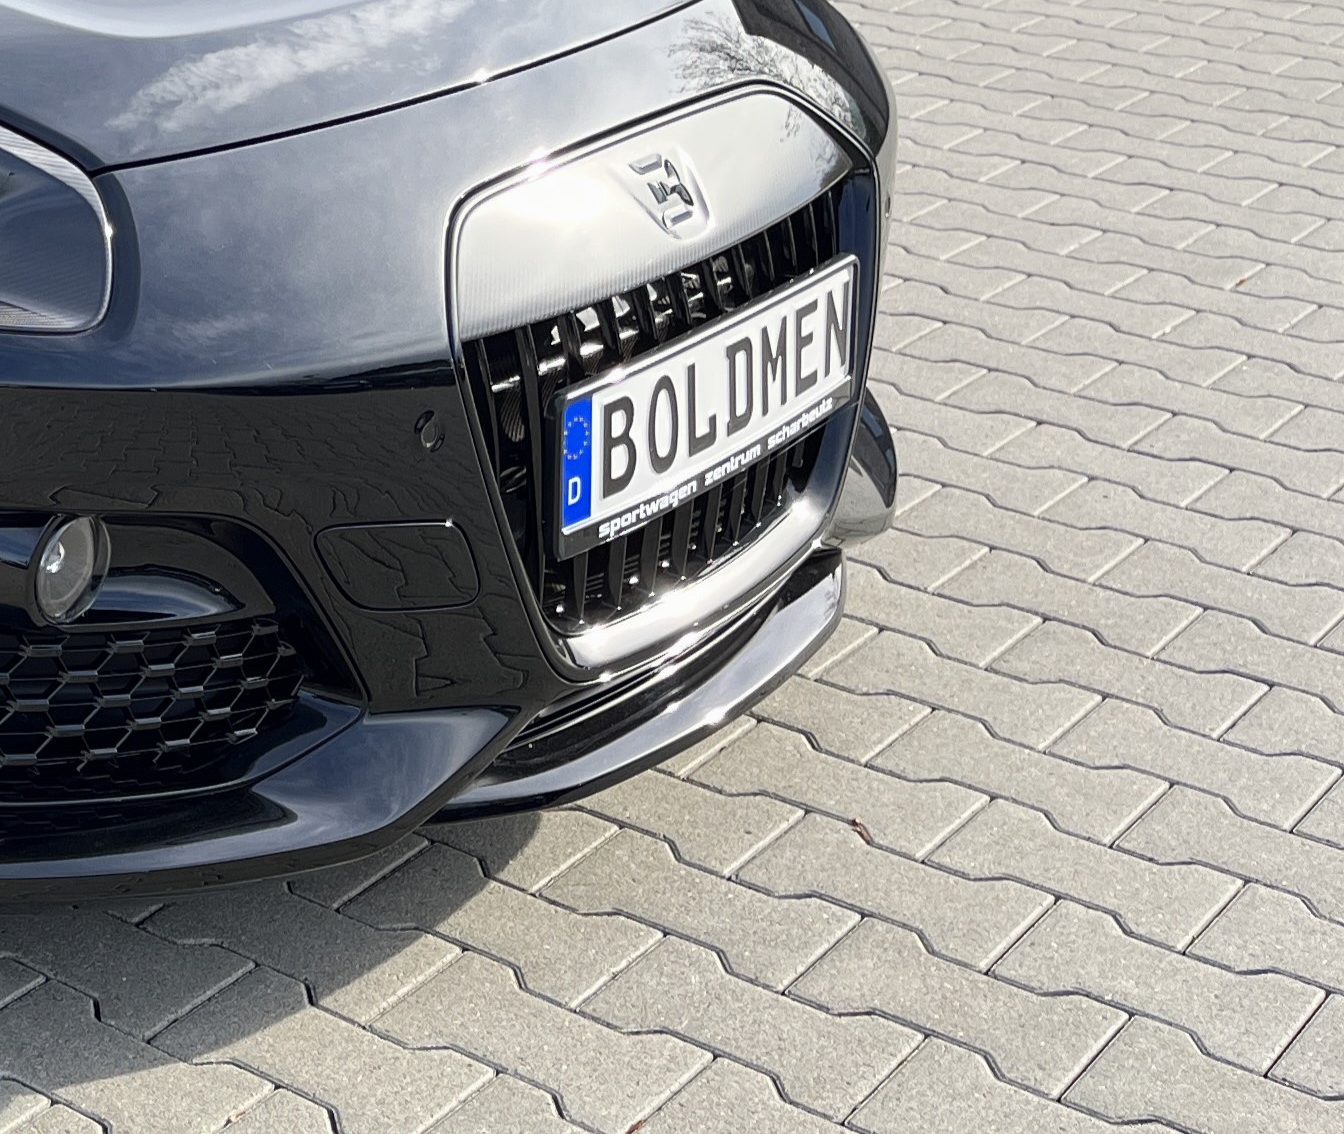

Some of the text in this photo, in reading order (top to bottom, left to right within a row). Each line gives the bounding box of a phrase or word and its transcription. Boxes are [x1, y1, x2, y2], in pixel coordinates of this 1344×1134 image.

[601, 280, 850, 500] BOLDMEN
[567, 475, 582, 506] D
[598, 396, 833, 539] sportwagen zentrum scharbeutz
